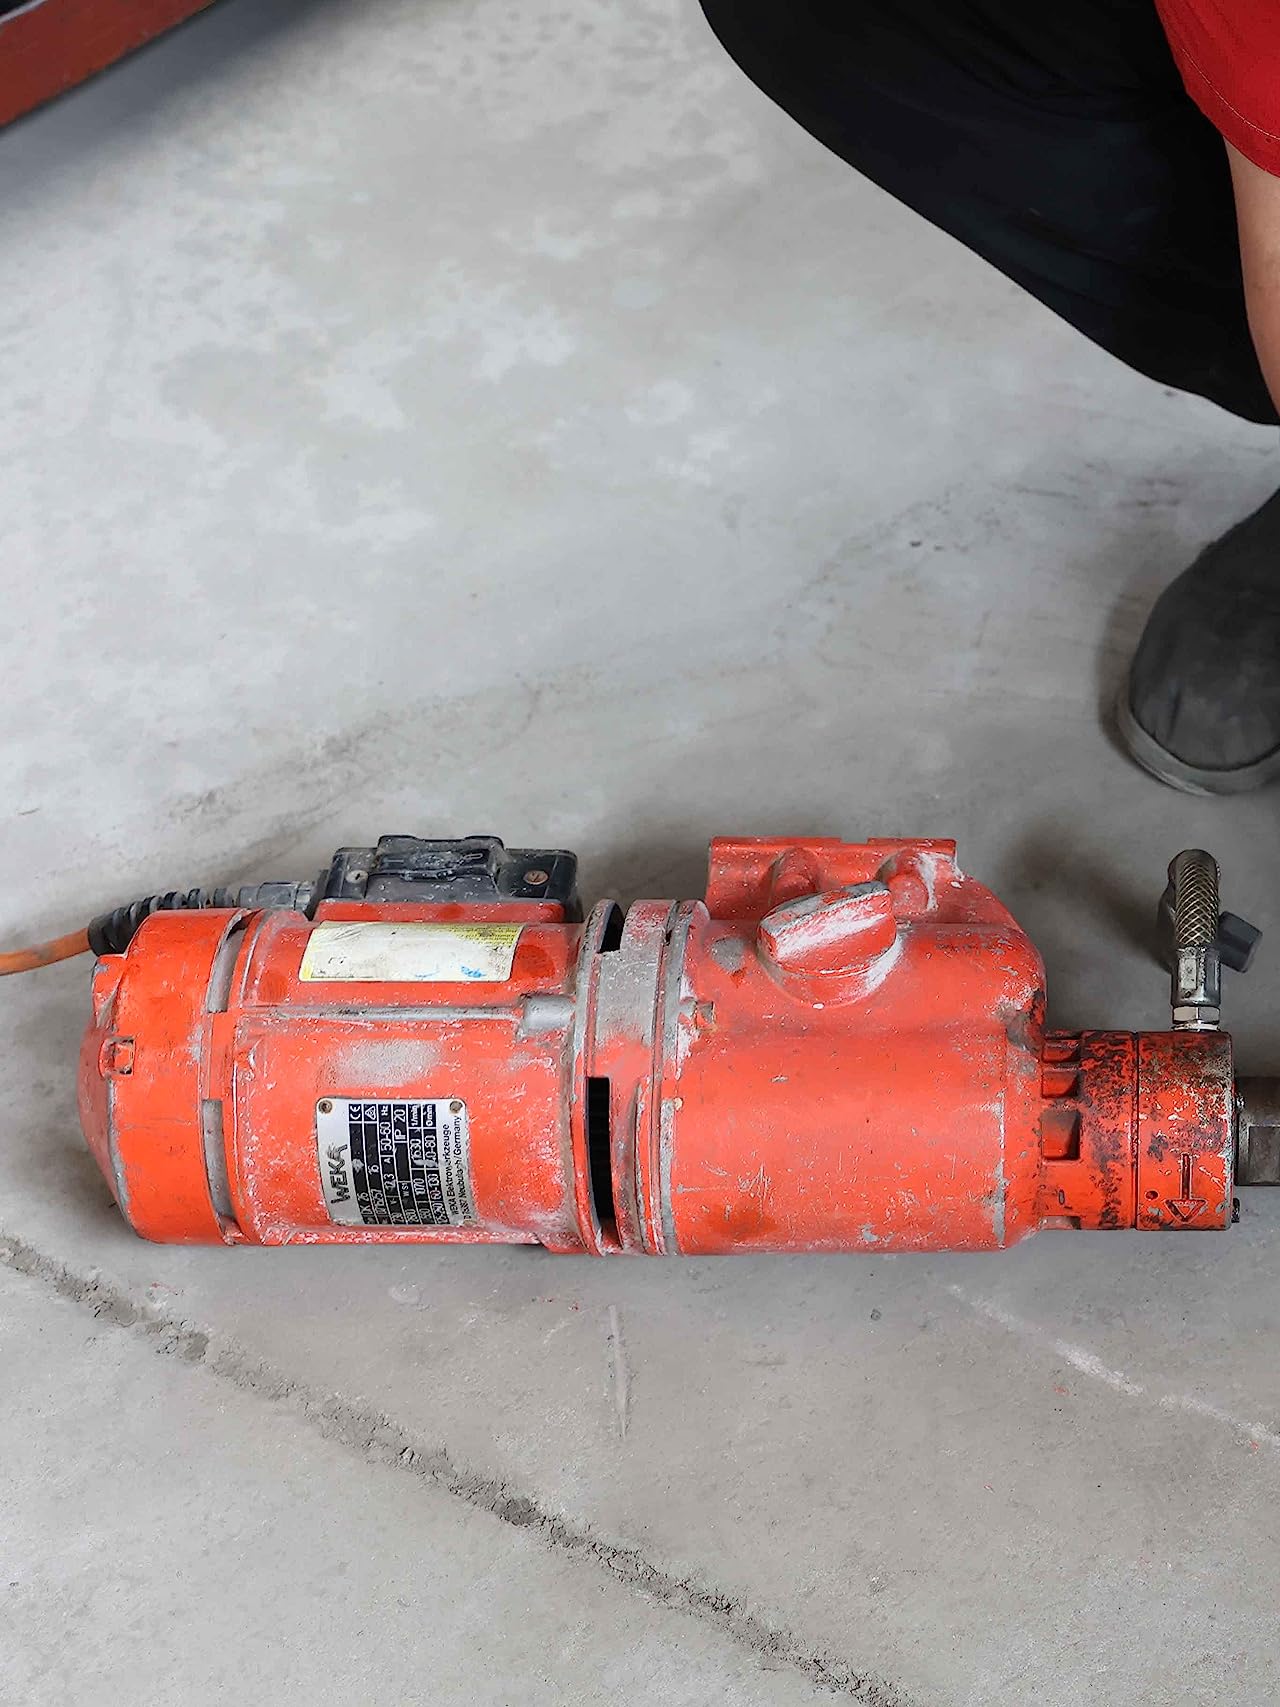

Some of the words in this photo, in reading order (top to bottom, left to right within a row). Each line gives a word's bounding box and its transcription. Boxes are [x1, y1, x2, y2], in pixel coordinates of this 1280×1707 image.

[381, 1105, 388, 1116] Hz
[394, 1109, 405, 1122] 20
[380, 1122, 392, 1151] 50-60
[396, 1129, 406, 1140] IP
[411, 1139, 422, 1159] 1630
[326, 1143, 350, 1203] WEKA
[413, 1178, 424, 1195] 1070
